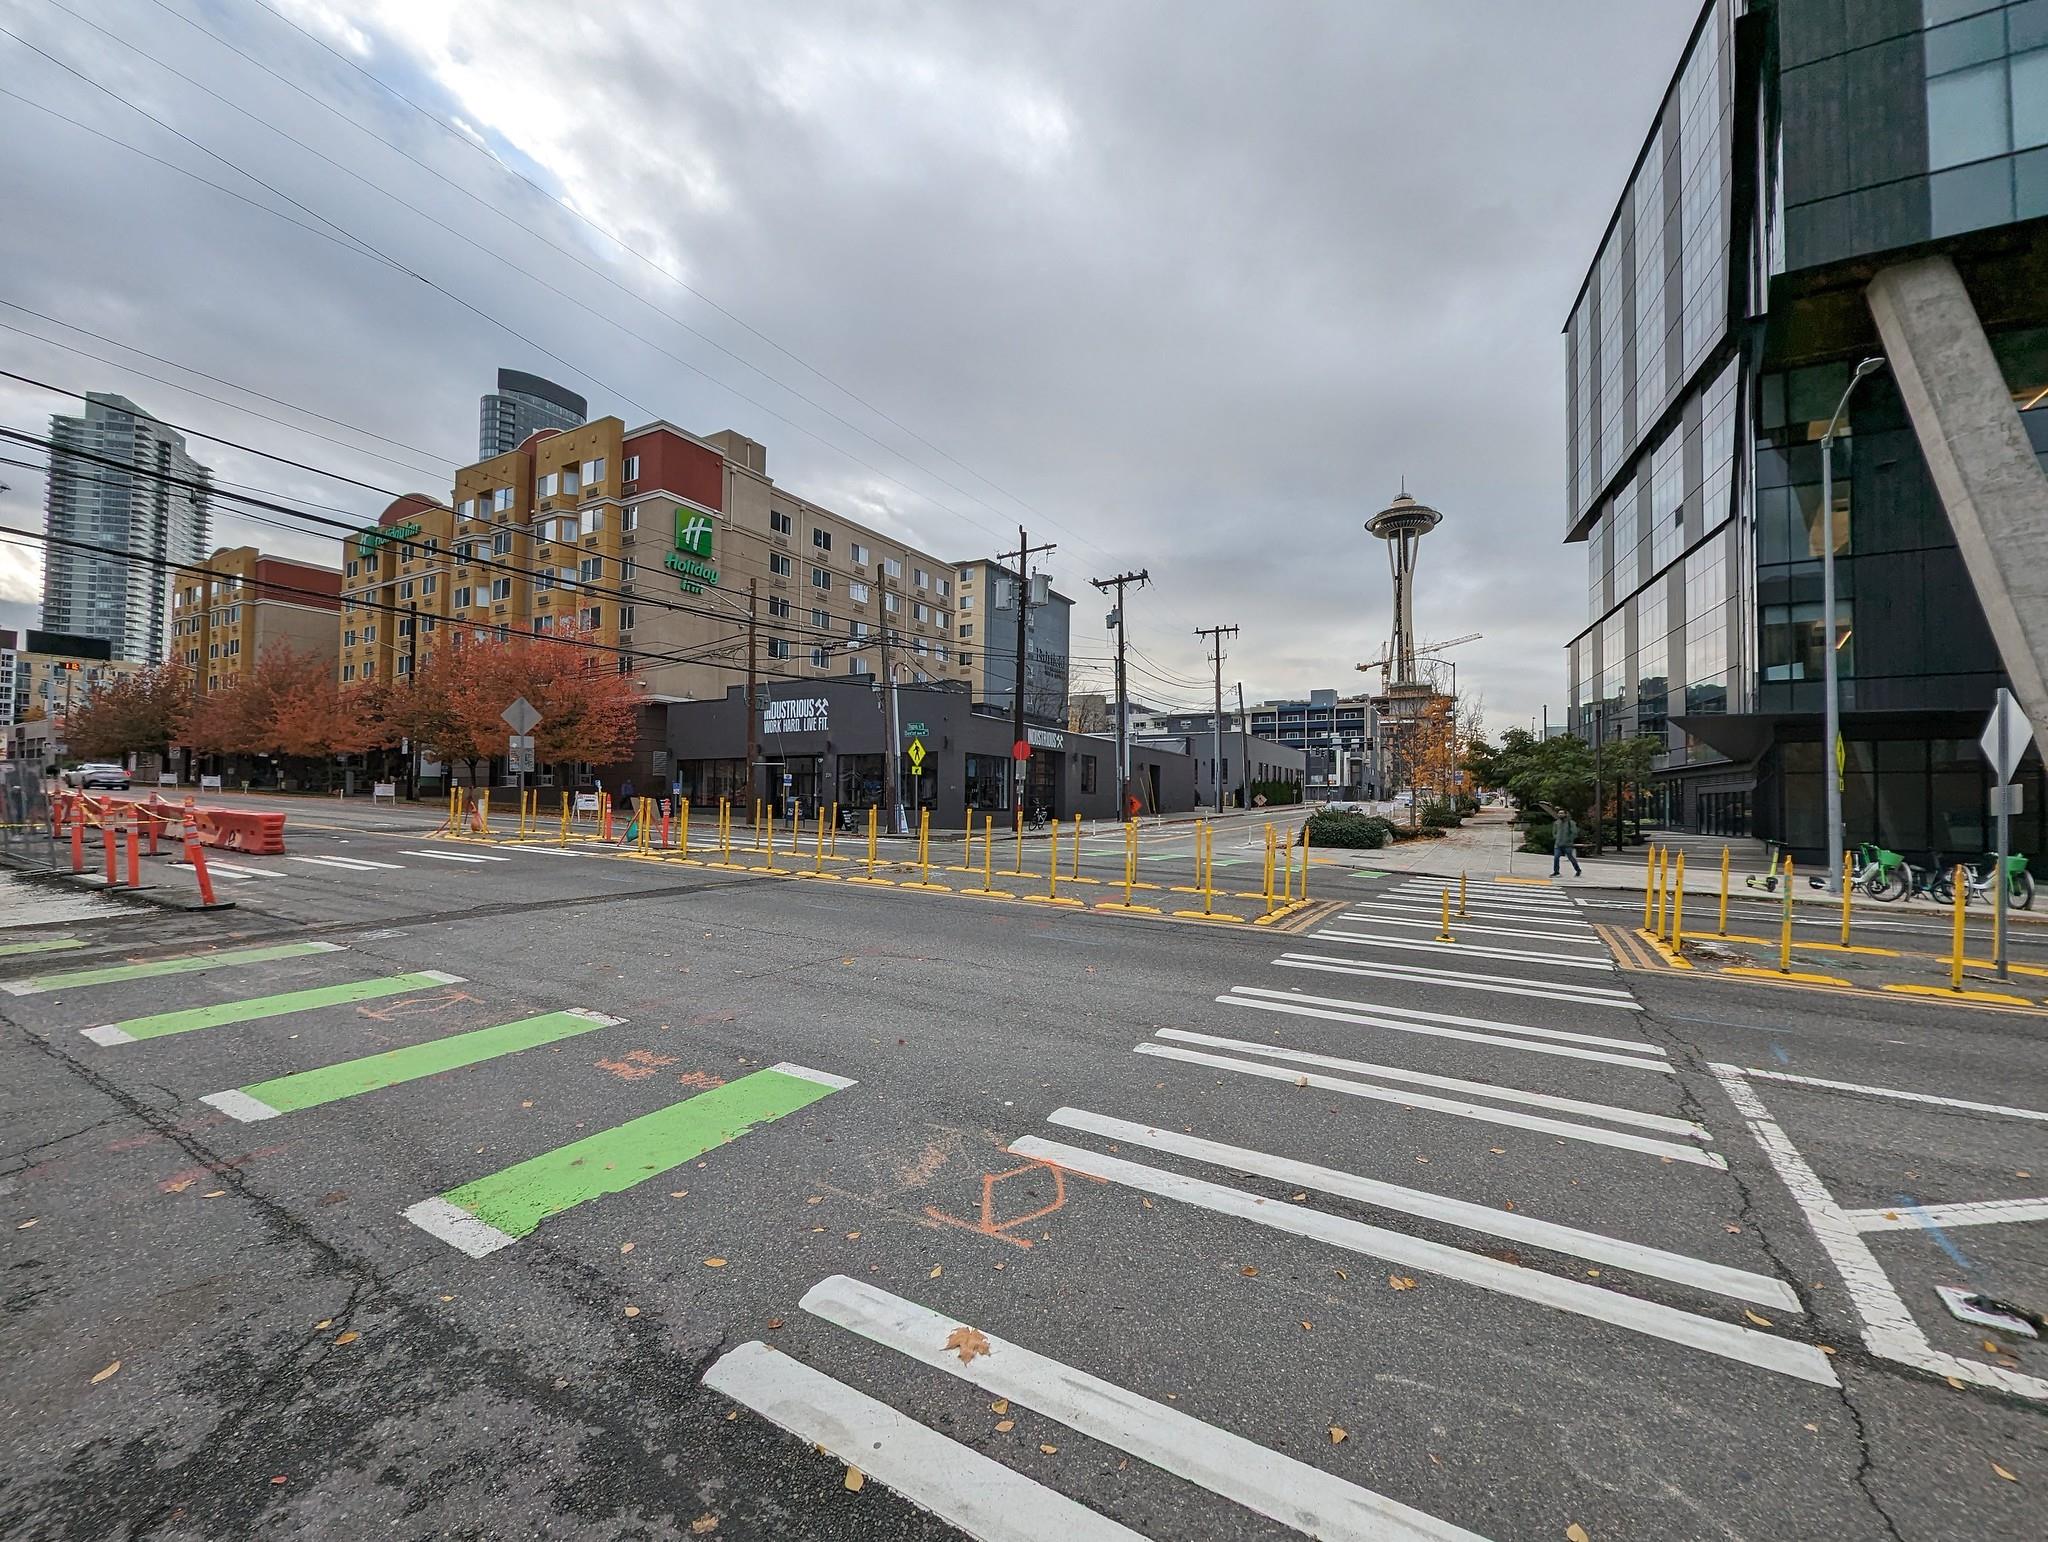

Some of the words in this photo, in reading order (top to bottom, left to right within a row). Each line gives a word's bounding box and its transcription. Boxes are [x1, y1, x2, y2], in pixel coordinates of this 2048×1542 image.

[665, 551, 719, 585] Holiday
[764, 698, 815, 720] INDUSTRIOUS
[763, 719, 782, 734] WORK
[803, 717, 817, 732] LIVE
[818, 716, 829, 731] FIT.
